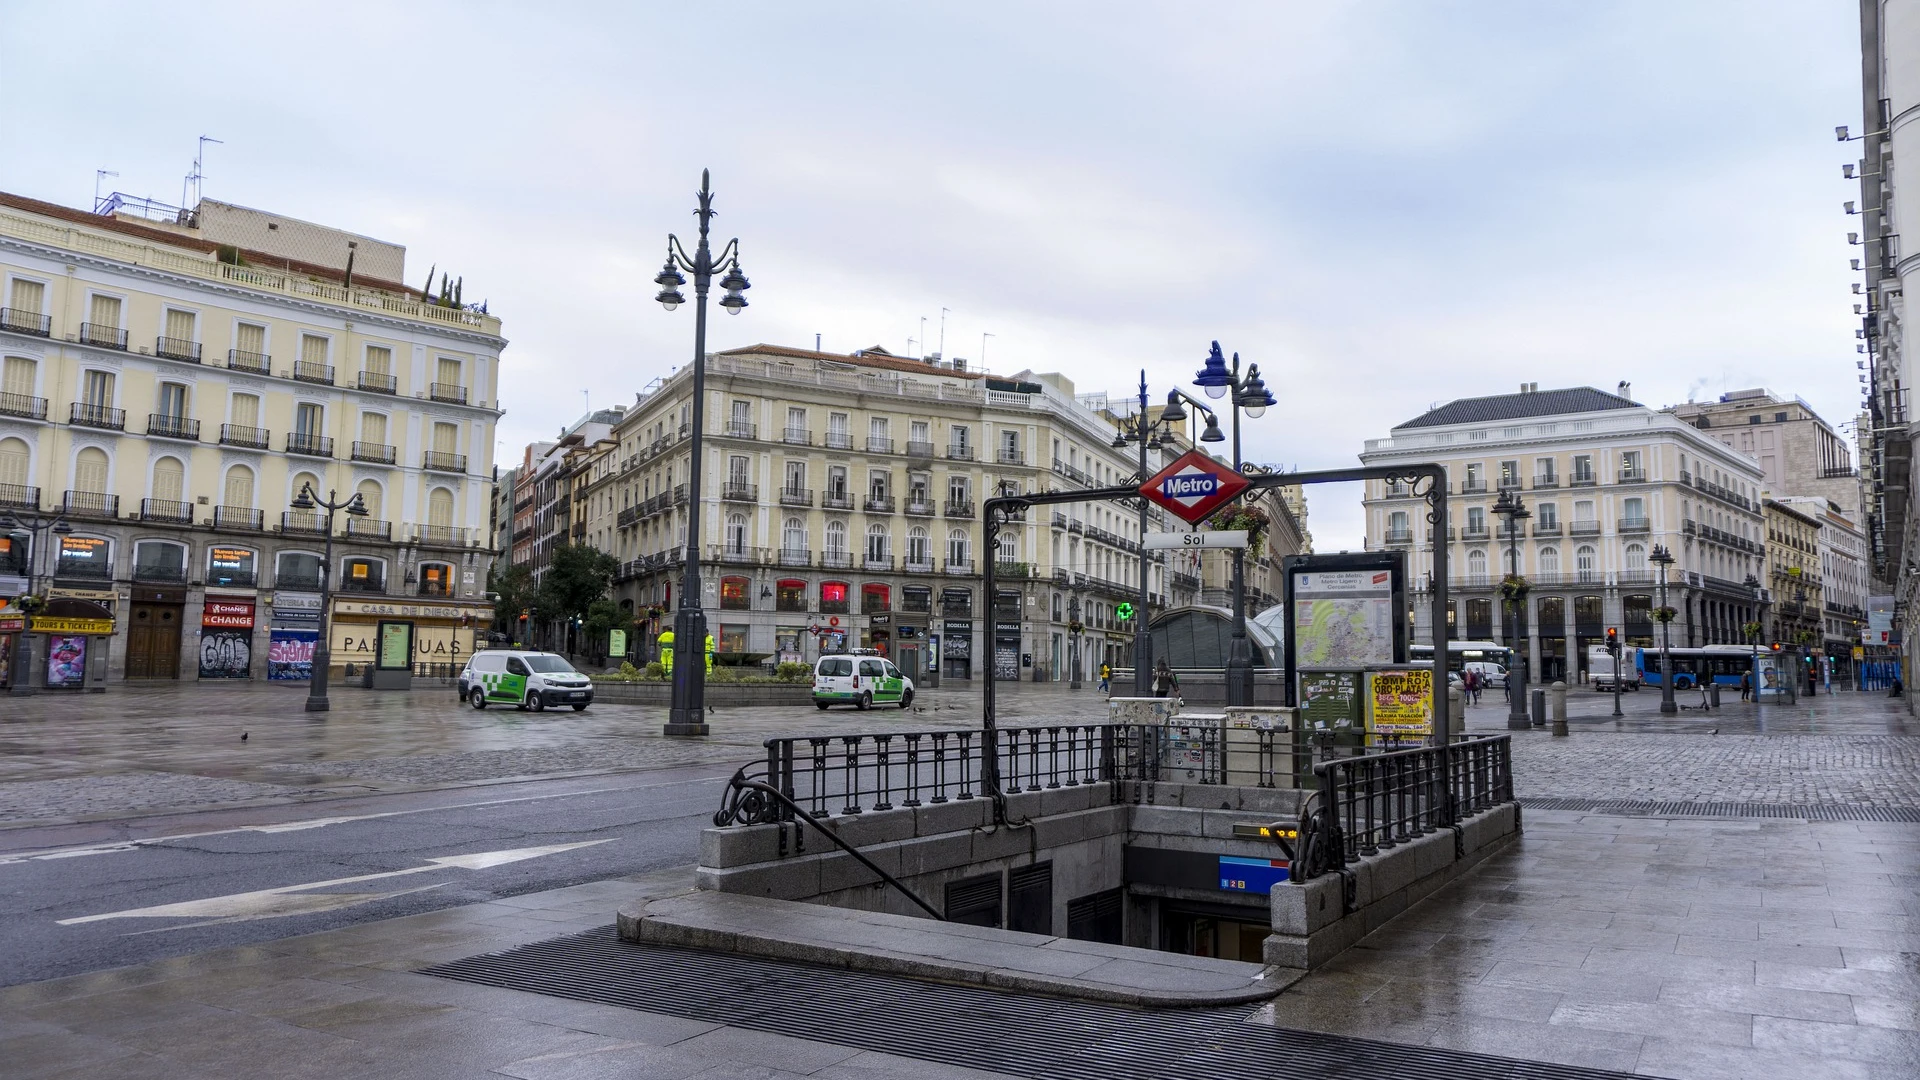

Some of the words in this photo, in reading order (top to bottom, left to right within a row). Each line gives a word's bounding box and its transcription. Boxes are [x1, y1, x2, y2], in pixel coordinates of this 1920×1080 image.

[1167, 478, 1213, 494] Metro
[1183, 534, 1205, 545] Sol
[220, 605, 248, 613] CHANGE
[361, 604, 394, 614] CASA
[401, 606, 418, 616] DE
[423, 606, 460, 617] DIEGO
[211, 615, 252, 625] CHANGE
[36, 621, 58, 629] TOURS
[68, 622, 96, 631] TICKETS
[344, 637, 461, 655] PAUAS
[1374, 677, 1422, 685] COMPRO
